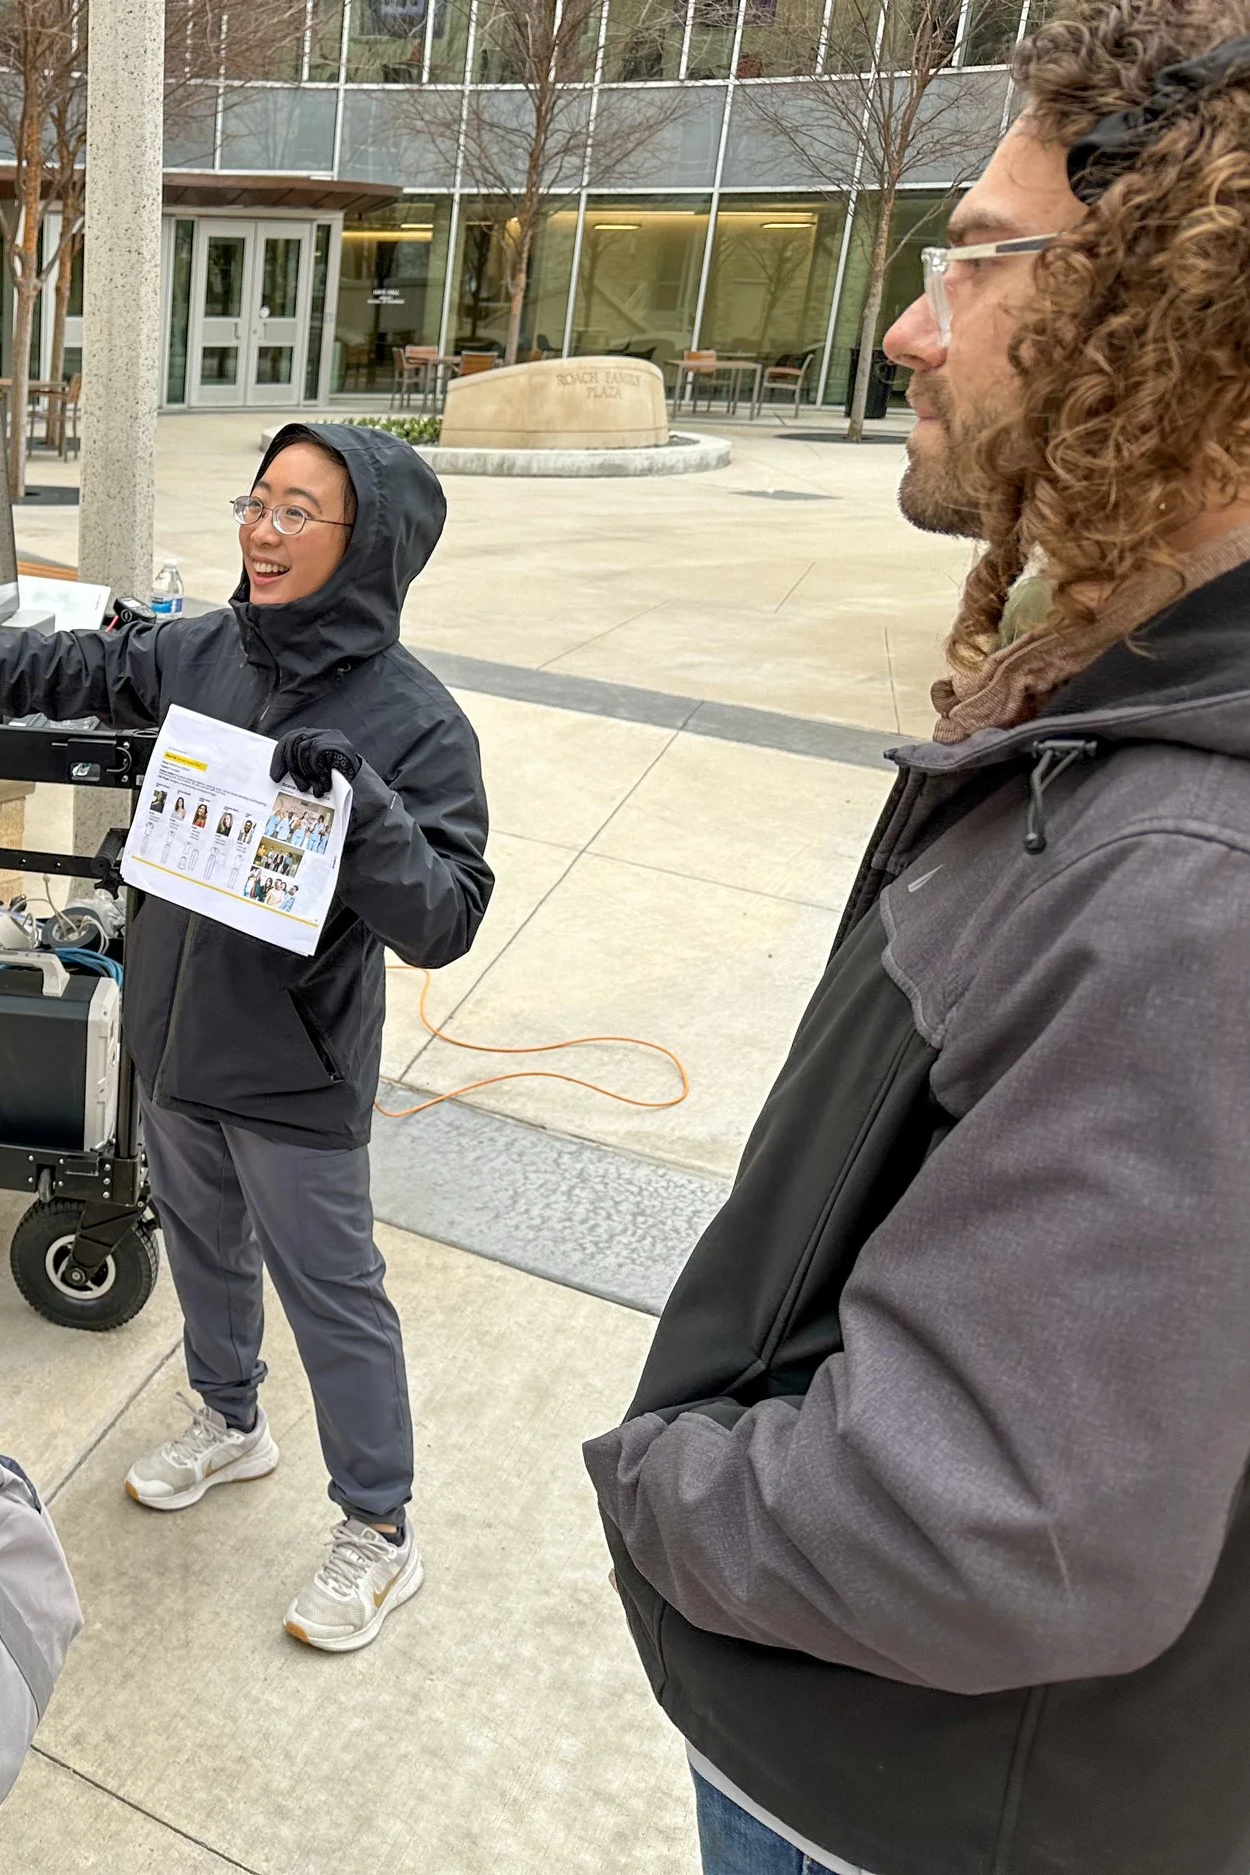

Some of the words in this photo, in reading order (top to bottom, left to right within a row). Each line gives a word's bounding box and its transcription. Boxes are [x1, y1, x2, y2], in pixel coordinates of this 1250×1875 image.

[556, 371, 598, 386] ROACH
[604, 371, 641, 387] FAMILY
[587, 386, 622, 399] PLAZA
